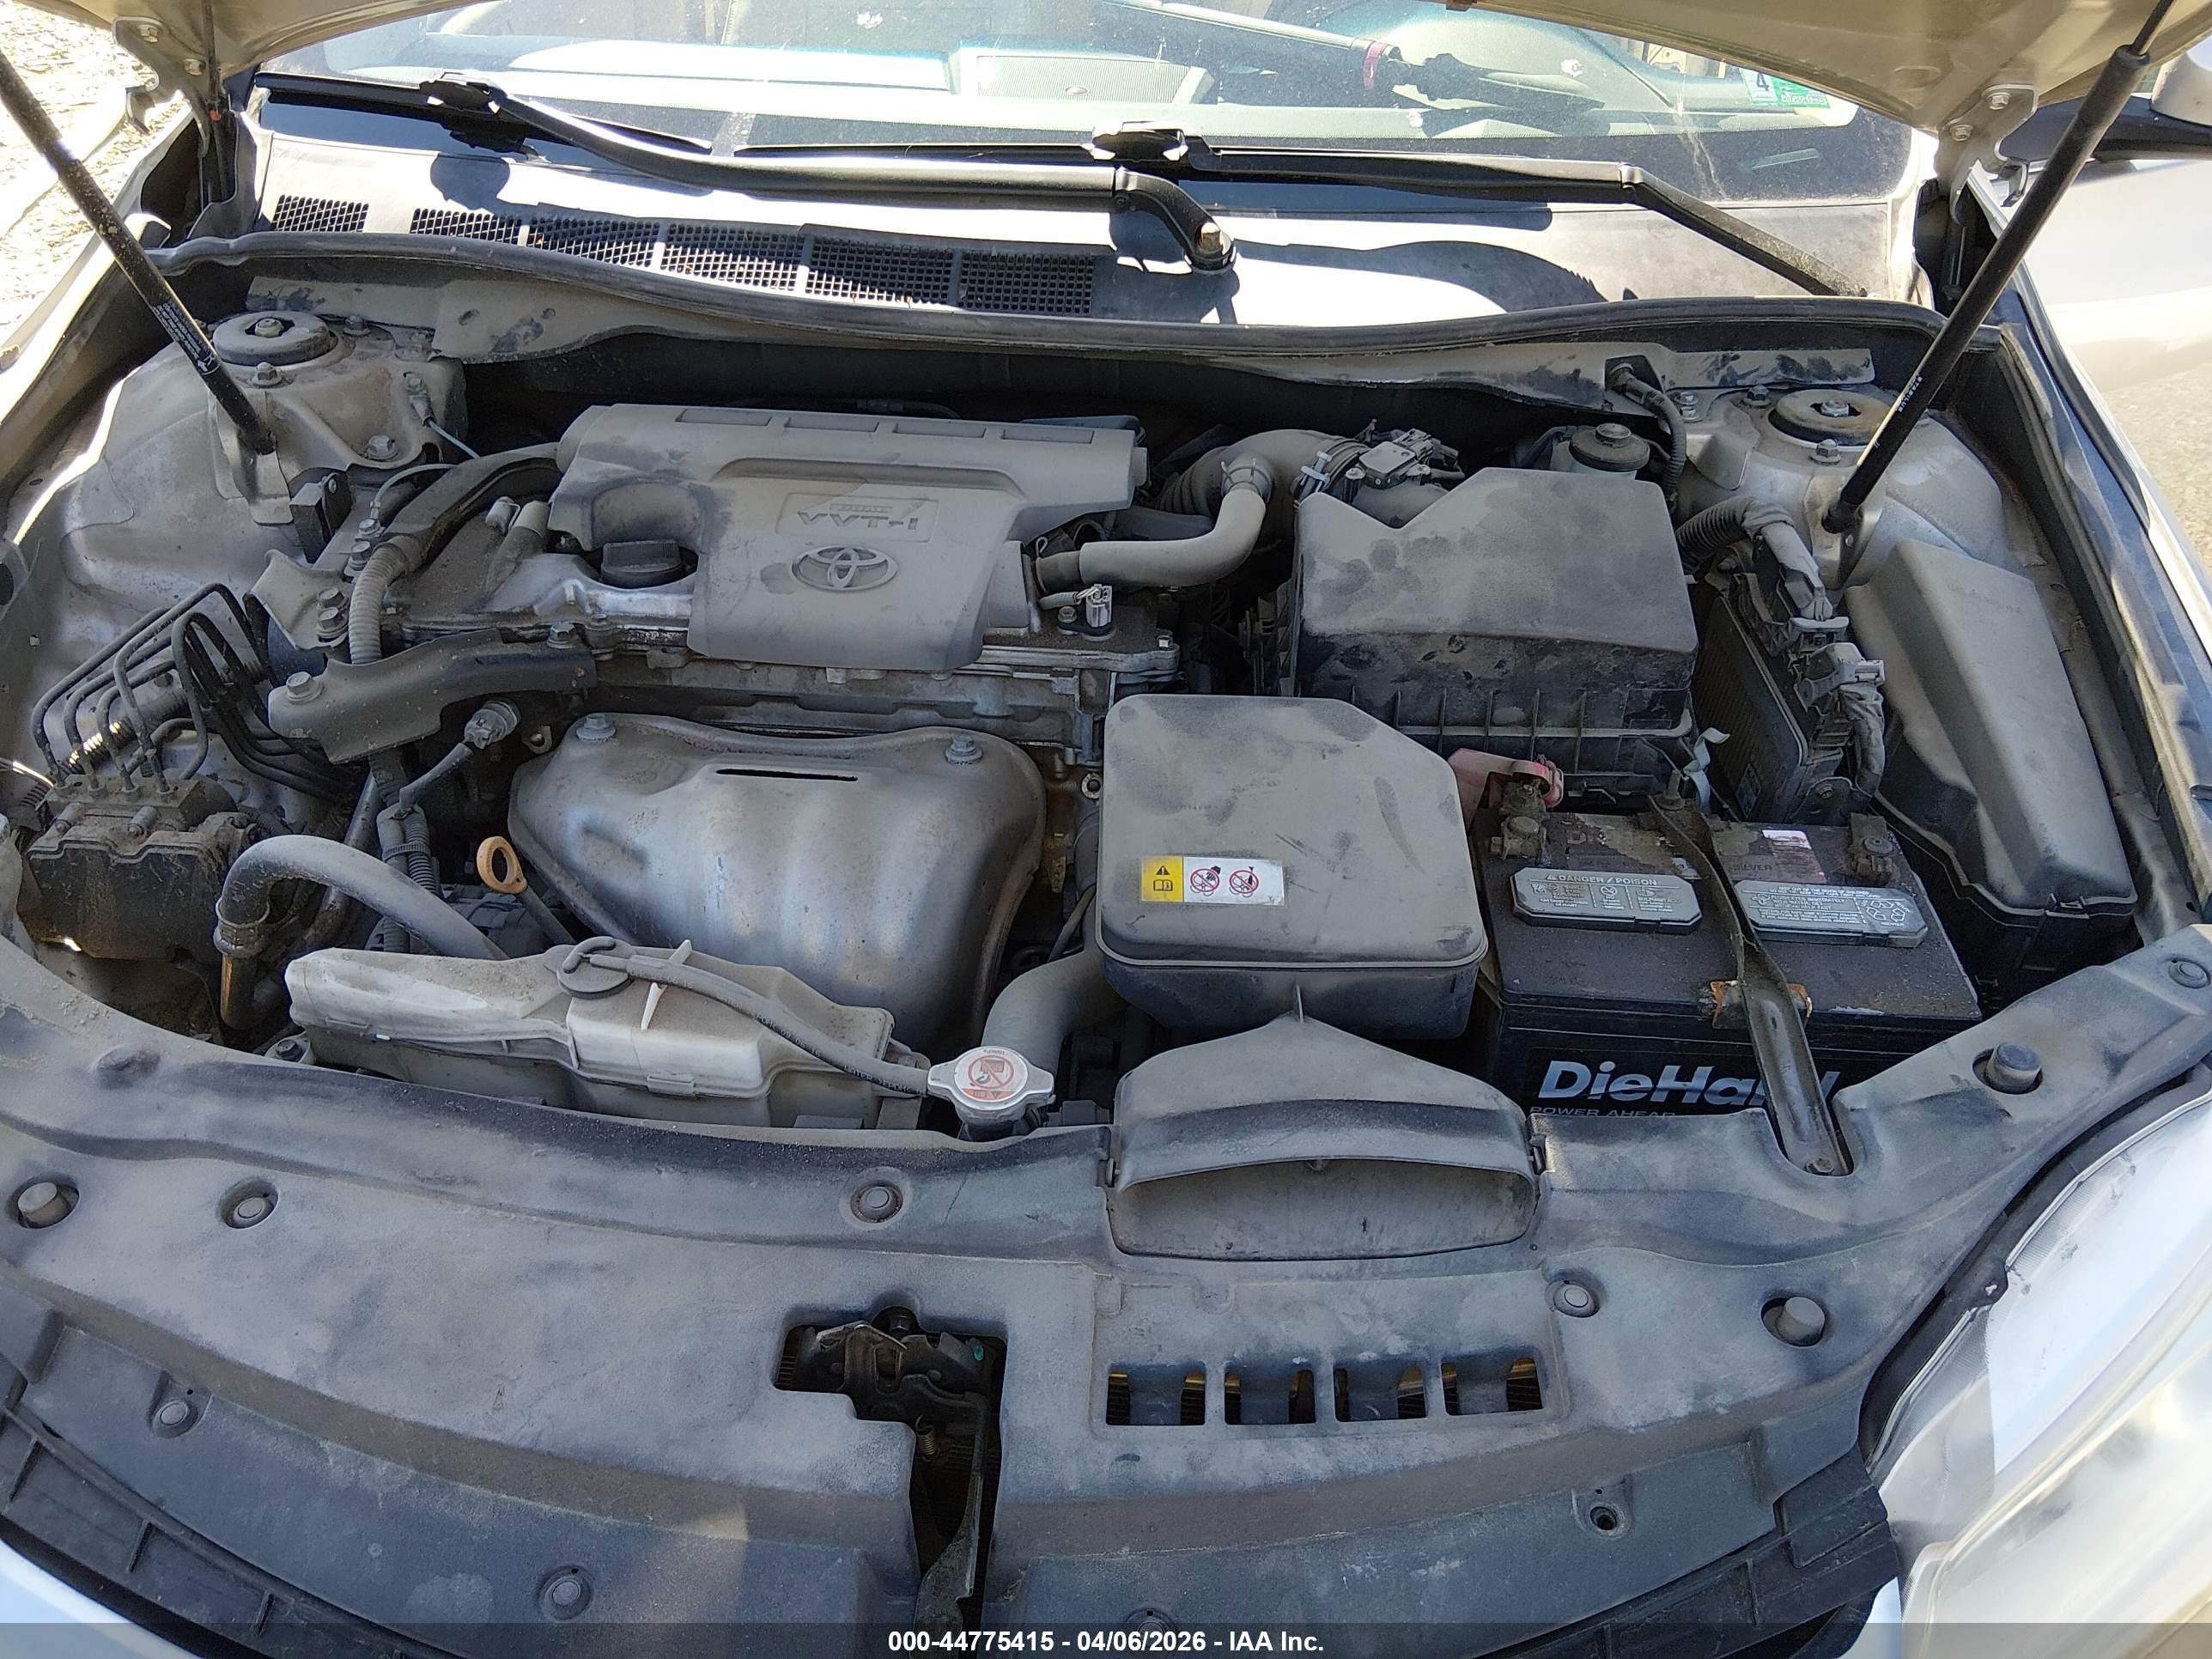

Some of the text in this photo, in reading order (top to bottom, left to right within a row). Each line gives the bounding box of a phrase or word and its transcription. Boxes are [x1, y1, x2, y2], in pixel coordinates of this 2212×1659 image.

[1756, 71, 1770, 92] 4
[1559, 874, 1605, 884] DANGER
[1615, 878, 1658, 886] POISON
[1538, 1060, 1840, 1106] DieHa
[1528, 1106, 1599, 1116] POWER
